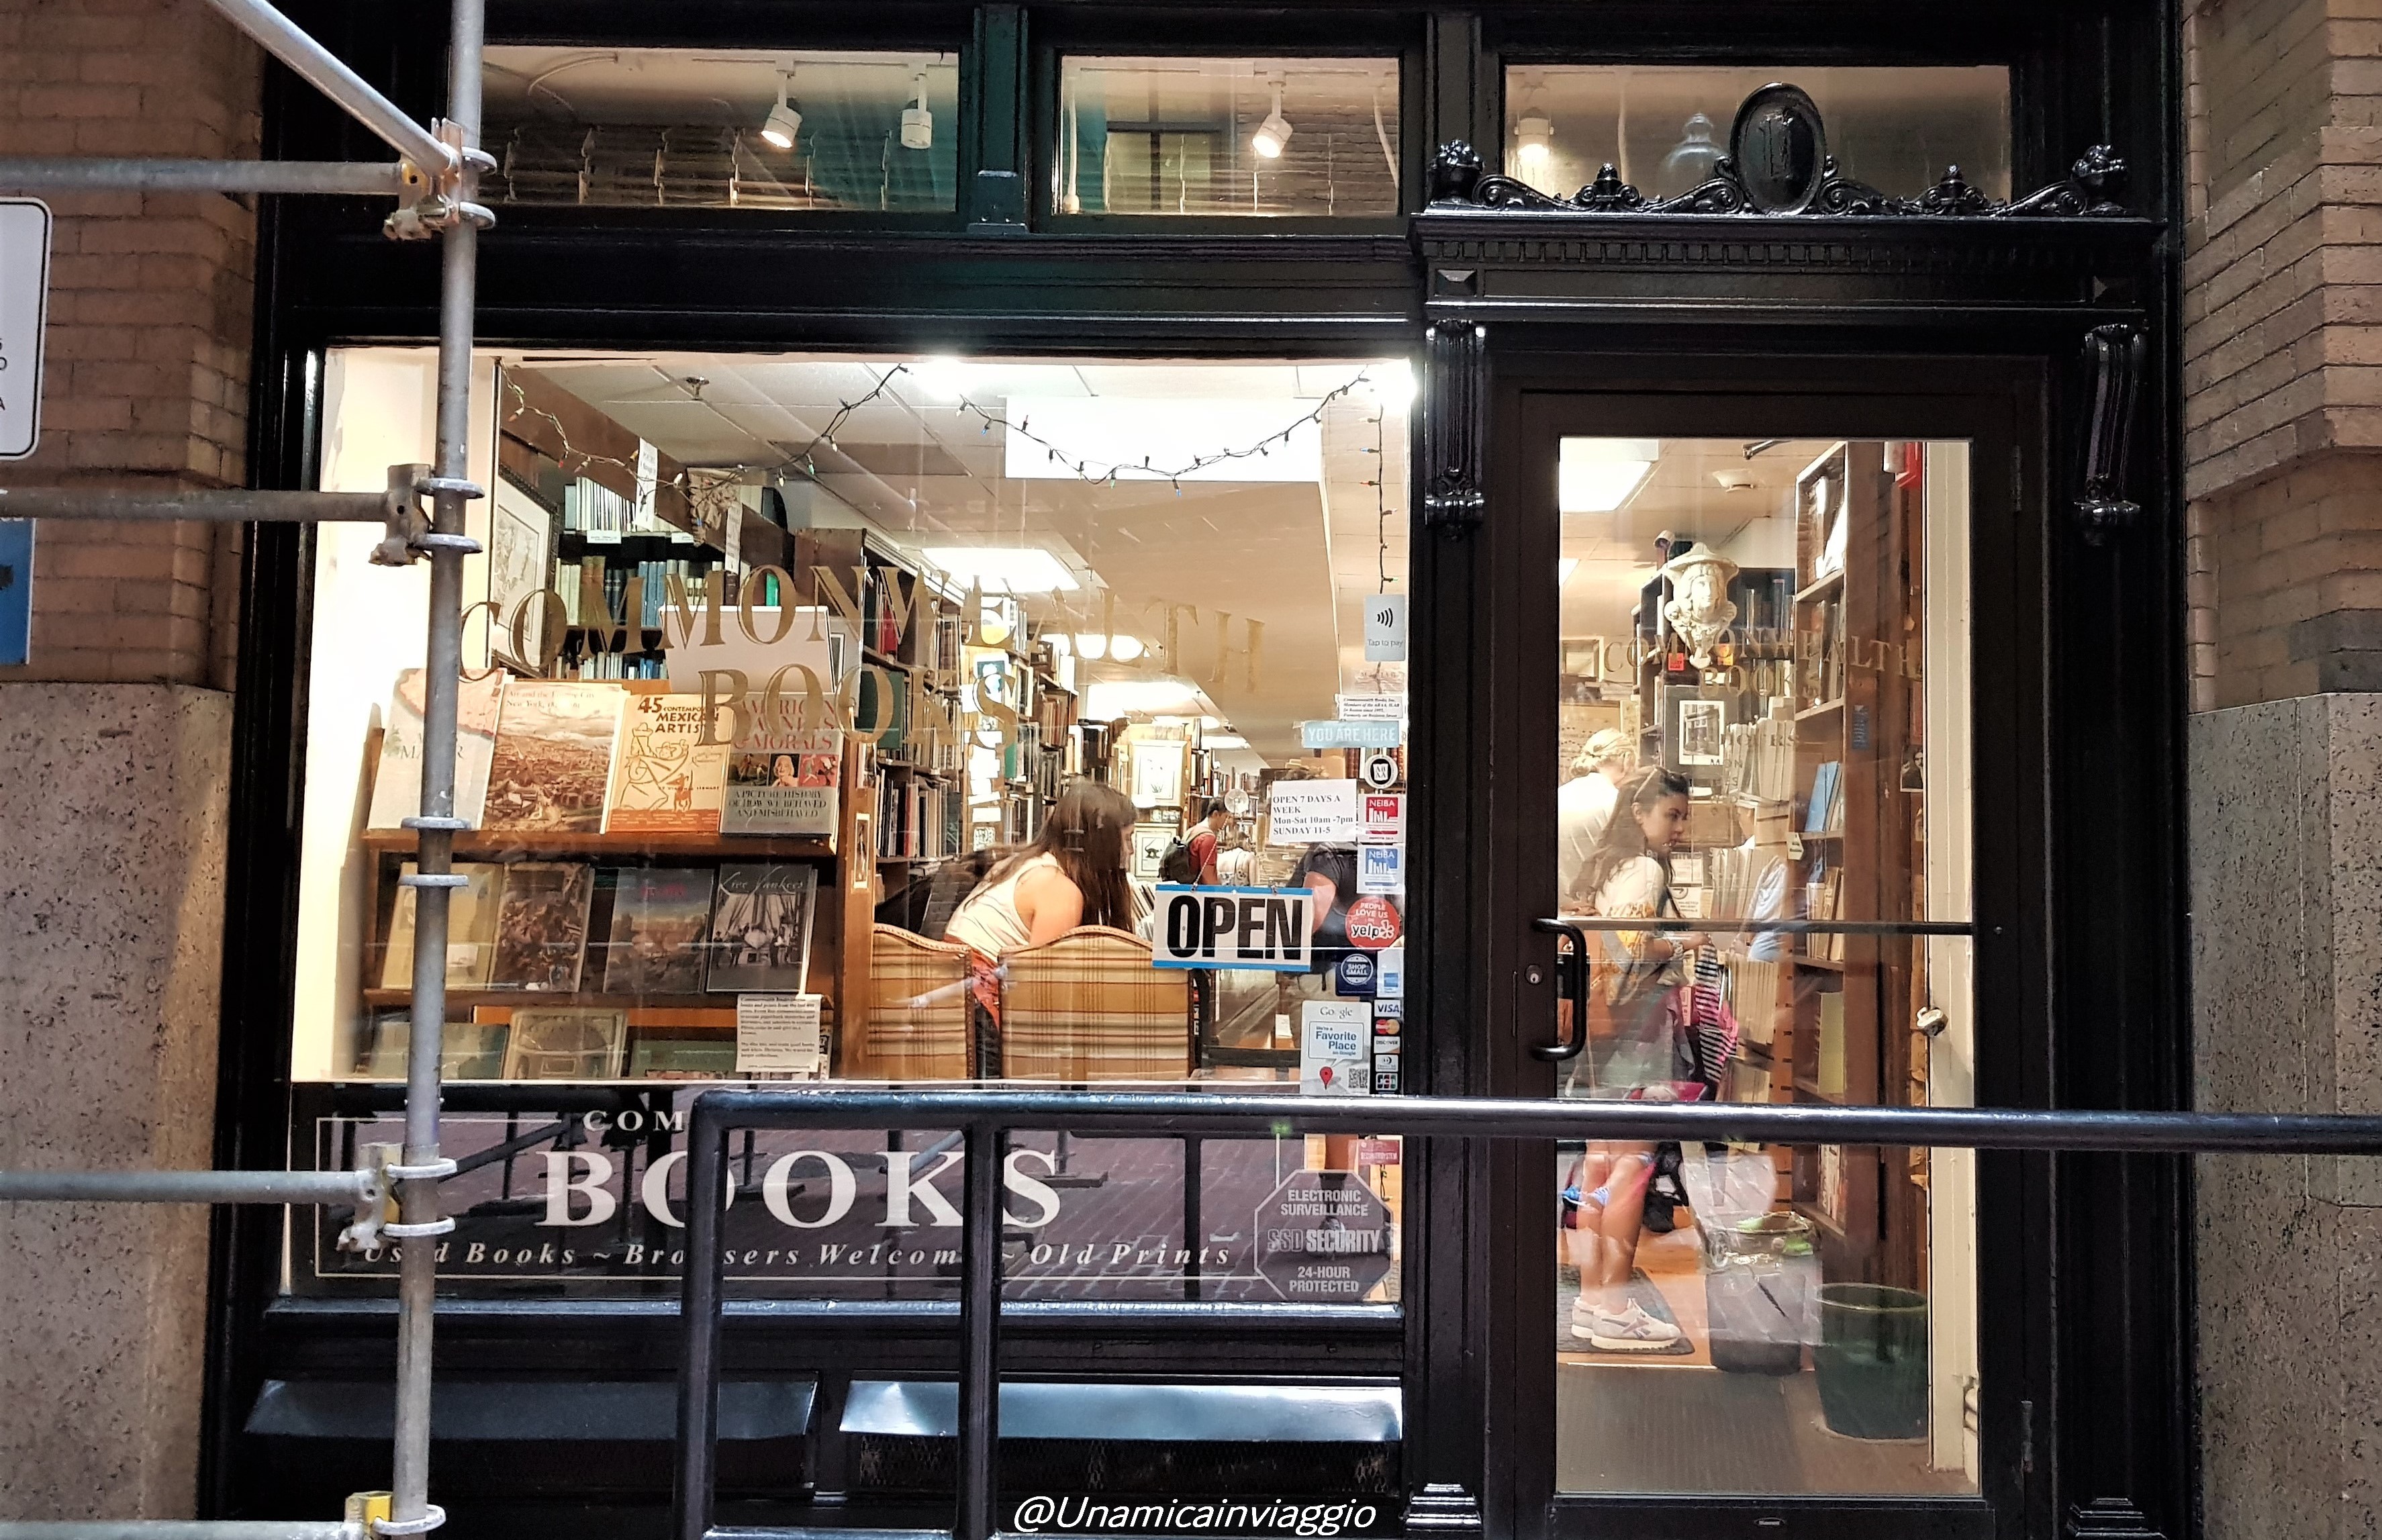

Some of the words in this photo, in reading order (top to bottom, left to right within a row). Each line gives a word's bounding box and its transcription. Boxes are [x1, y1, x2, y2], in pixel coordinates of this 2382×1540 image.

[1367, 638, 1380, 646] Tap
[1390, 639, 1403, 648] pay
[638, 697, 663, 713] 45
[696, 663, 1019, 749] BOOKS
[741, 700, 835, 714] MRICN
[655, 723, 716, 734] ARTIS
[1308, 728, 1333, 742] YOU
[1337, 728, 1360, 742] ARE
[1363, 728, 1396, 741] HERE
[1273, 796, 1298, 804] OPEN
[1307, 795, 1332, 803] DAYS
[1369, 799, 1395, 807] NEIBA
[1273, 816, 1307, 824] Mon-Sat
[1310, 816, 1331, 824] 10am
[1333, 815, 1353, 825] -7pm
[1273, 826, 1311, 835] SUNDAY
[1314, 826, 1331, 834] 11-5
[1368, 851, 1395, 859] NEIBA
[1360, 902, 1386, 911] PEOPLE
[1355, 908, 1377, 917] LOVE
[1378, 910, 1388, 918] US
[1167, 894, 1303, 960] OPEN
[1352, 924, 1380, 939] yelp
[1320, 1006, 1353, 1019] Gogle
[1377, 1004, 1400, 1012] VISA
[1315, 1030, 1357, 1041] Favorite
[1328, 1041, 1357, 1051] Place
[534, 1149, 1061, 1229] BOOKS
[1287, 1189, 1362, 1203] ELECTRONIC
[1280, 1204, 1368, 1216] SURVEILLANCE
[1267, 1228, 1304, 1253] SSD
[1306, 1229, 1381, 1253] SECURITY
[364, 1242, 450, 1263] Usd
[465, 1242, 576, 1263] Books
[623, 1243, 799, 1265] Brosers
[819, 1244, 957, 1265] Welcom
[1030, 1242, 1093, 1265] Old
[1110, 1242, 1231, 1265] Prints
[1297, 1265, 1350, 1278] 24-HOUR
[1288, 1279, 1360, 1292] PROTECTED
